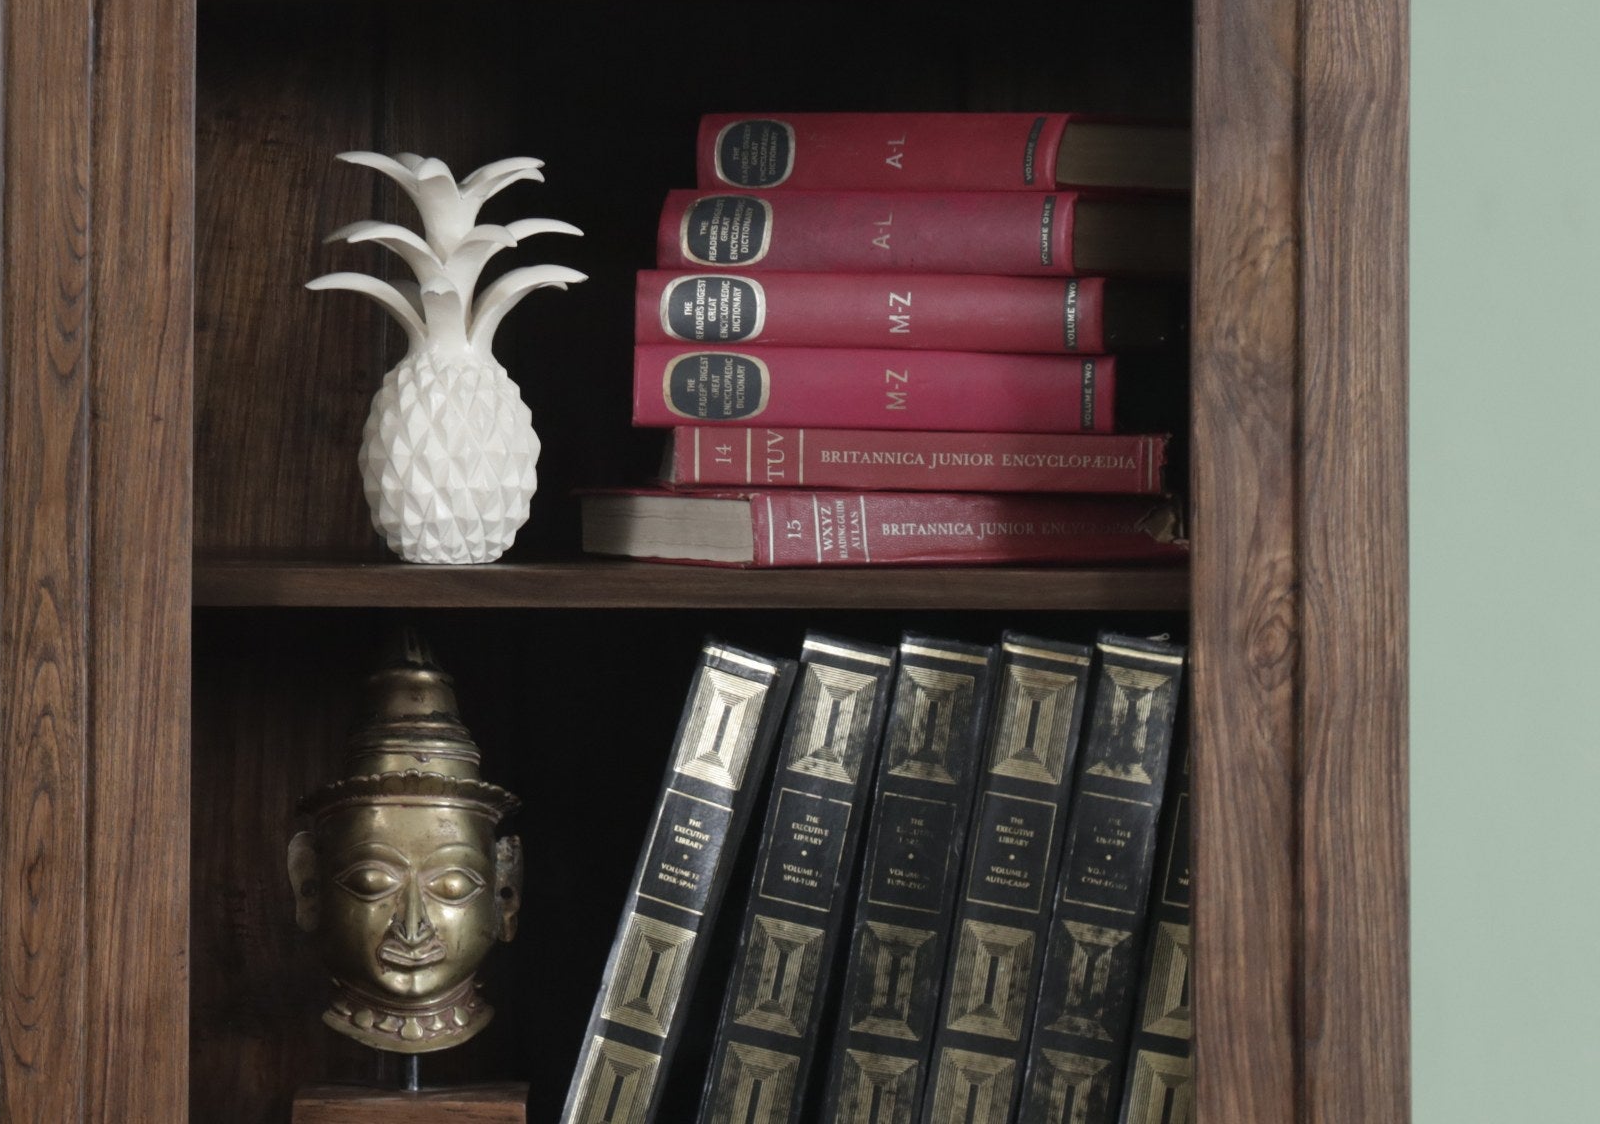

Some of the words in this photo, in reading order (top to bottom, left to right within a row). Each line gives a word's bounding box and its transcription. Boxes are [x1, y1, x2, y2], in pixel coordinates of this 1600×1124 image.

[751, 141, 759, 166] GREAT
[769, 131, 779, 175] DICTIONARY
[885, 131, 907, 169] A-L
[1024, 142, 1034, 181] VOLUME
[712, 199, 725, 224] DIGEST
[1042, 203, 1052, 224] ONE
[700, 220, 709, 235] THE
[720, 217, 730, 242] GREAT
[741, 207, 754, 253] DICTIONARY
[872, 212, 893, 250] A-L
[1041, 227, 1050, 265] VOLUME
[696, 279, 706, 305] DIGEST
[1067, 282, 1077, 305] TWO
[684, 301, 693, 316] THE
[707, 296, 717, 322] GREAT
[732, 286, 742, 332] DICTIONARY
[888, 291, 912, 333] M-Z
[1067, 307, 1076, 347] VOLUME
[699, 356, 709, 382] DIGEST
[1084, 363, 1092, 385] TWO
[686, 378, 696, 392] THE
[736, 364, 746, 409] DICTIONARY
[885, 369, 908, 410] M-Z
[1083, 387, 1092, 427] VOLUME
[715, 443, 732, 464] 14
[766, 429, 785, 483] TUV
[820, 450, 925, 466] BRITANNICA
[929, 451, 995, 469] JUNIOR
[836, 500, 846, 524] GUIDE
[787, 519, 802, 539] 15
[820, 506, 833, 551] WXYZ
[838, 523, 849, 558] READING
[851, 511, 861, 550] ATLAS
[882, 522, 974, 537] BRITANNICA
[977, 523, 1035, 540] JUNIOR
[689, 818, 703, 829] THE
[791, 822, 830, 837] EXECUTIVE
[805, 814, 820, 824] THE
[996, 824, 1035, 838] EXECUTIVE
[1010, 816, 1024, 826] THE
[673, 824, 711, 842] EXECUTIVE
[674, 835, 704, 850] LIBRARY
[793, 833, 824, 846] LIBRARY
[998, 835, 1029, 847] LIBRARY
[661, 862, 691, 877] VOLUME
[782, 863, 813, 876] VOLUME
[990, 865, 1021, 878] VOLUME
